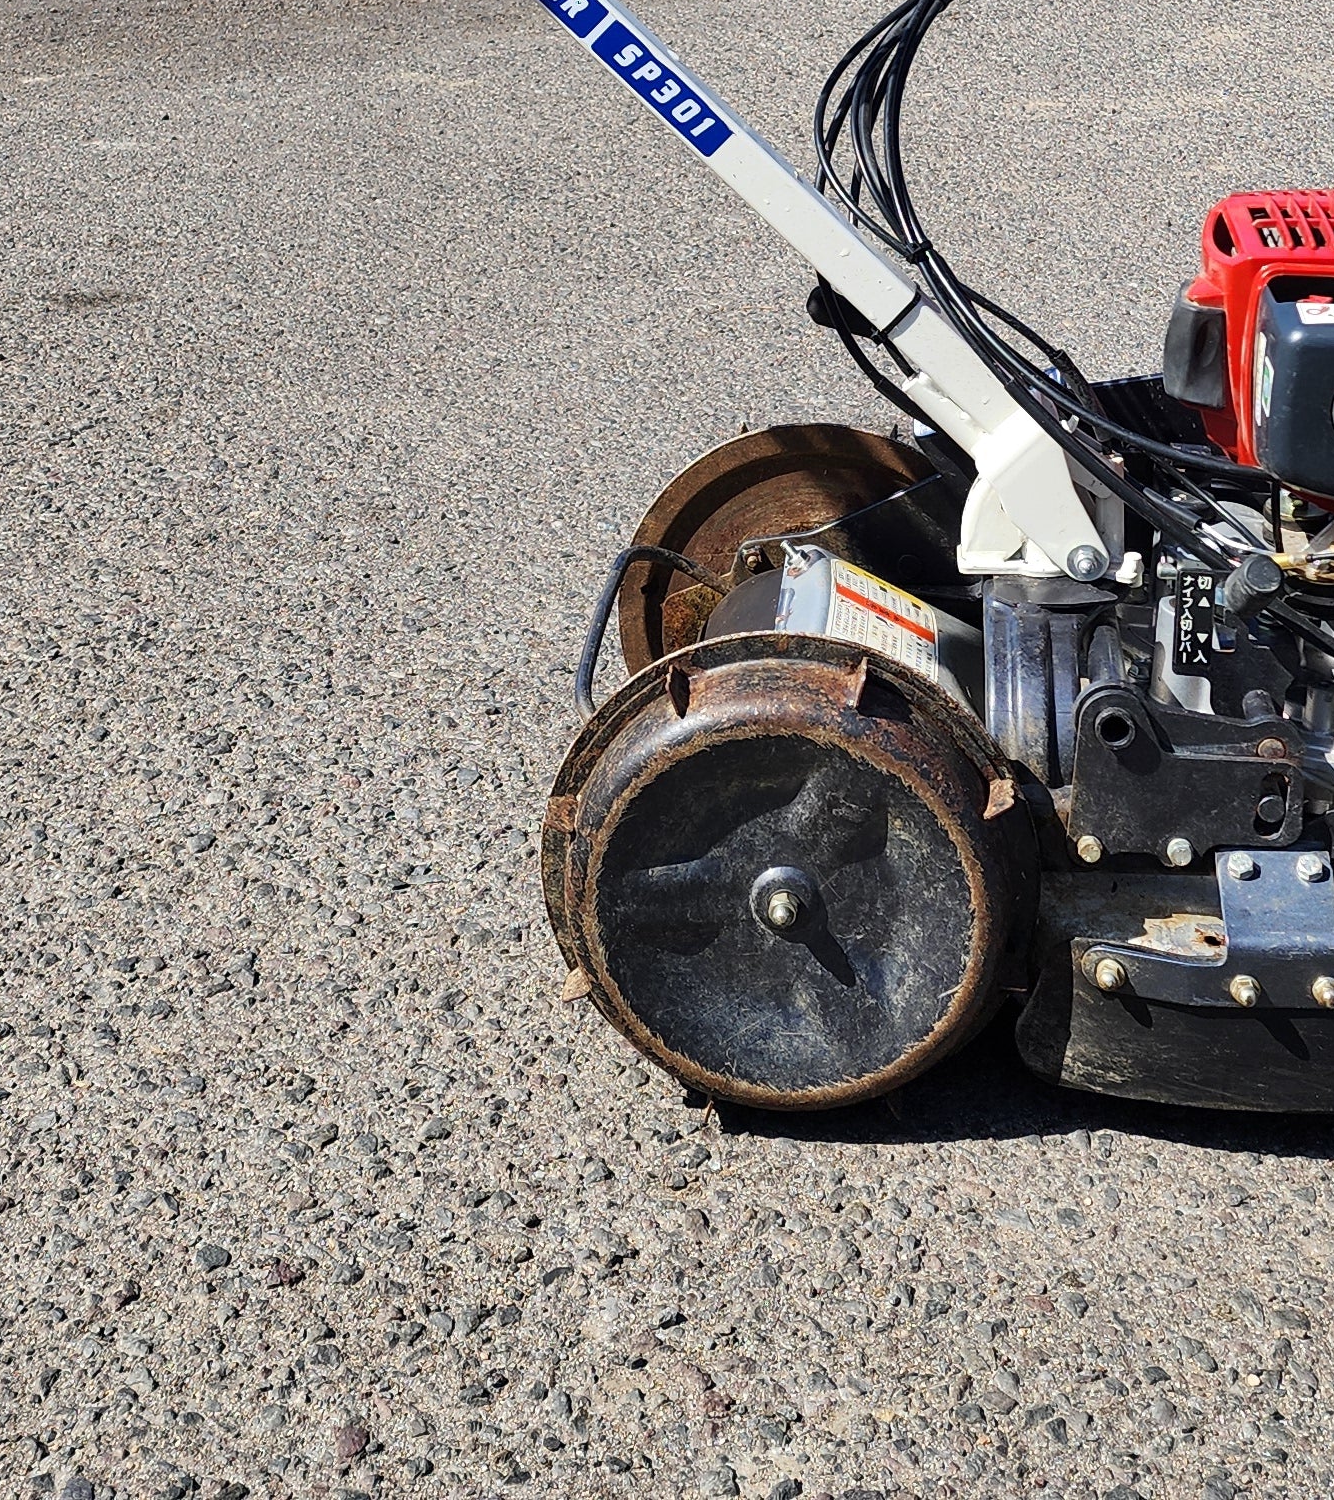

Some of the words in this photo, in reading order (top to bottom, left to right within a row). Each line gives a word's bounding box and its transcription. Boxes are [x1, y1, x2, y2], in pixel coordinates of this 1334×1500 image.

[613, 43, 717, 138] SP301
[1197, 575, 1213, 590] 切
[1179, 575, 1195, 663] ナイフ入切レバー
[1192, 649, 1208, 664] 入
